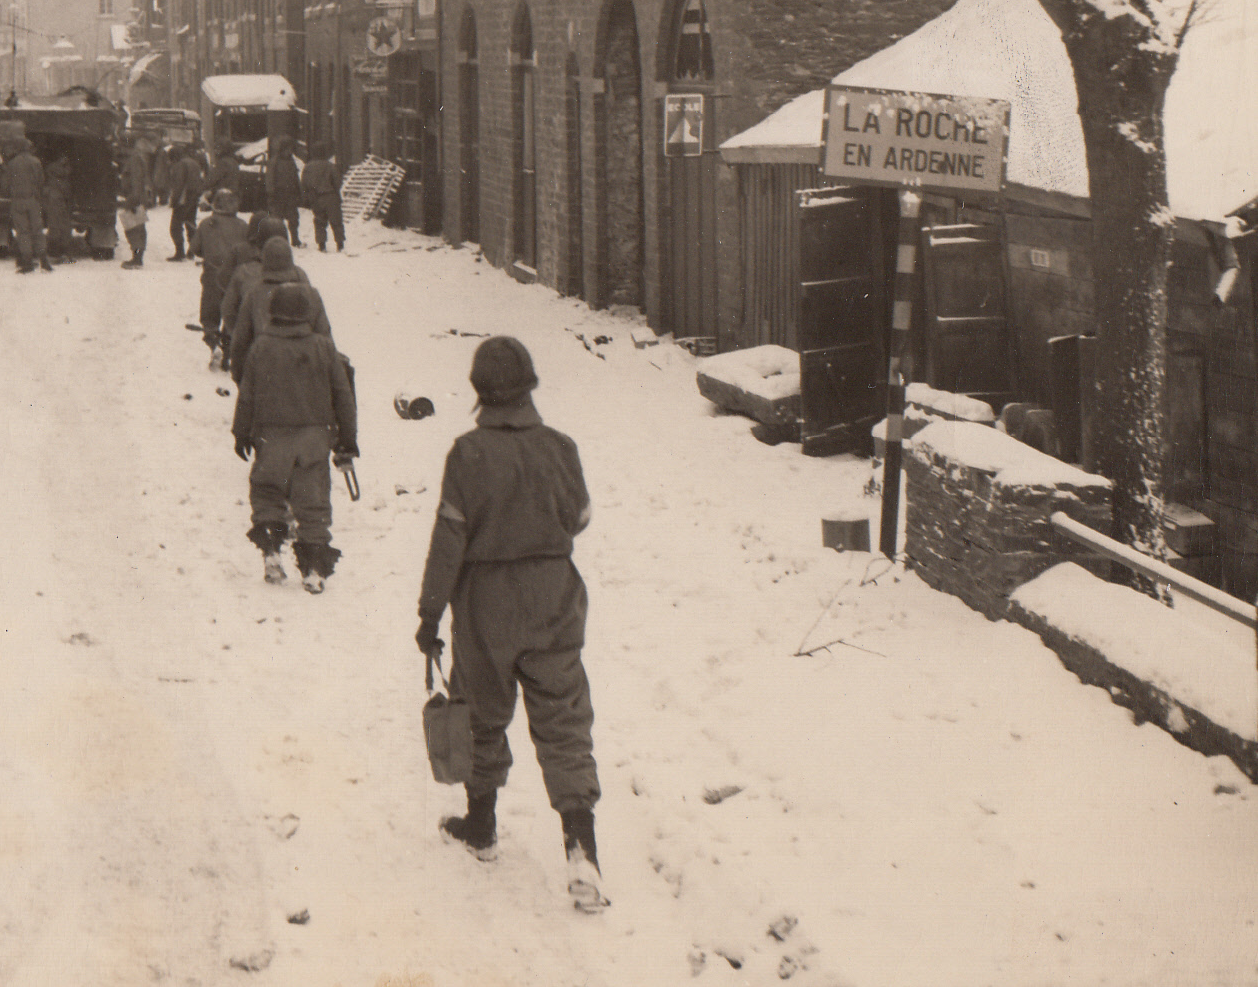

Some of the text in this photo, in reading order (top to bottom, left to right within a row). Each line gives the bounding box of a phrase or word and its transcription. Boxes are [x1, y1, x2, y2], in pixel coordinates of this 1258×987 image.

[843, 103, 989, 145] LA ROCHE
[843, 142, 986, 179] EN ARDENNE
